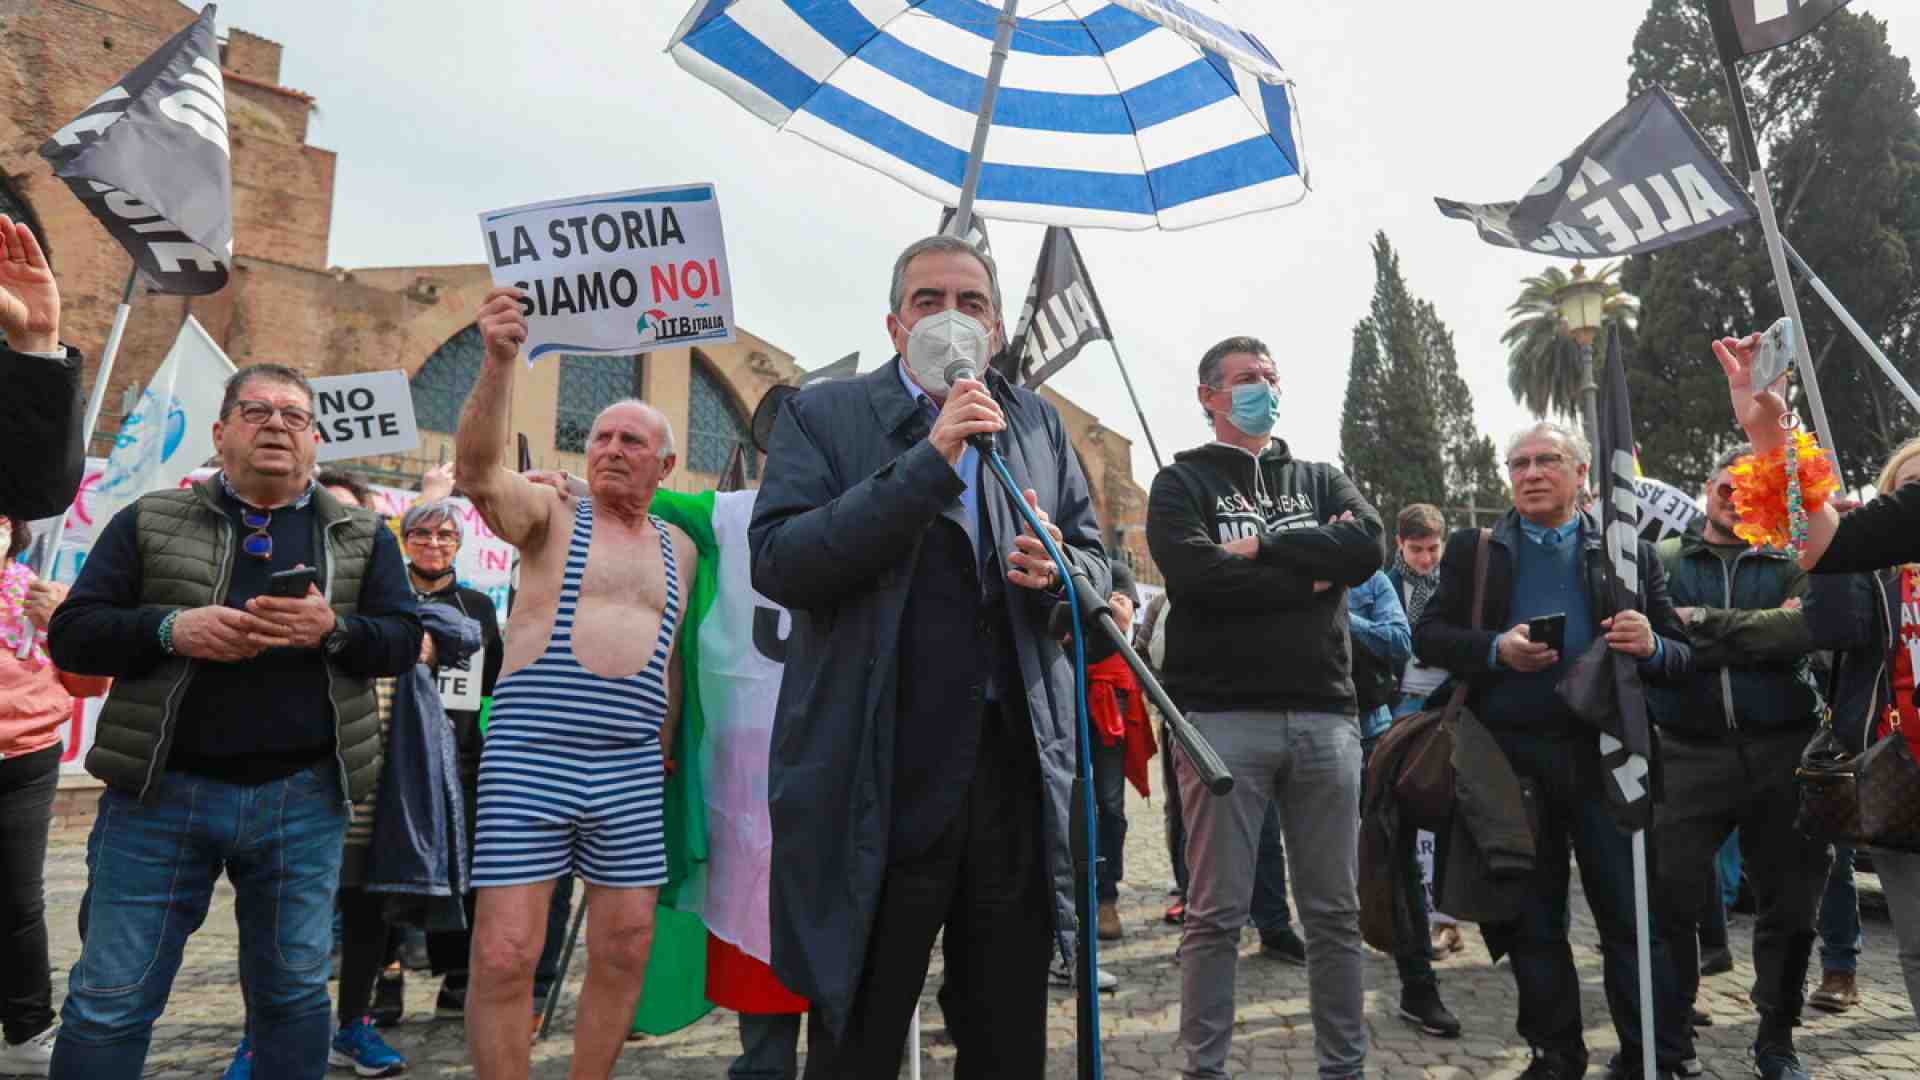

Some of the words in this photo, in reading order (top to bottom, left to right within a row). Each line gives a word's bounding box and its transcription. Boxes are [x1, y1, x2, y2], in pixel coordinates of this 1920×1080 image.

[488, 225, 541, 267] LA
[548, 206, 686, 259] STORIA
[513, 268, 638, 317] SIAMO
[650, 257, 720, 304] NOI
[318, 387, 375, 415] NO
